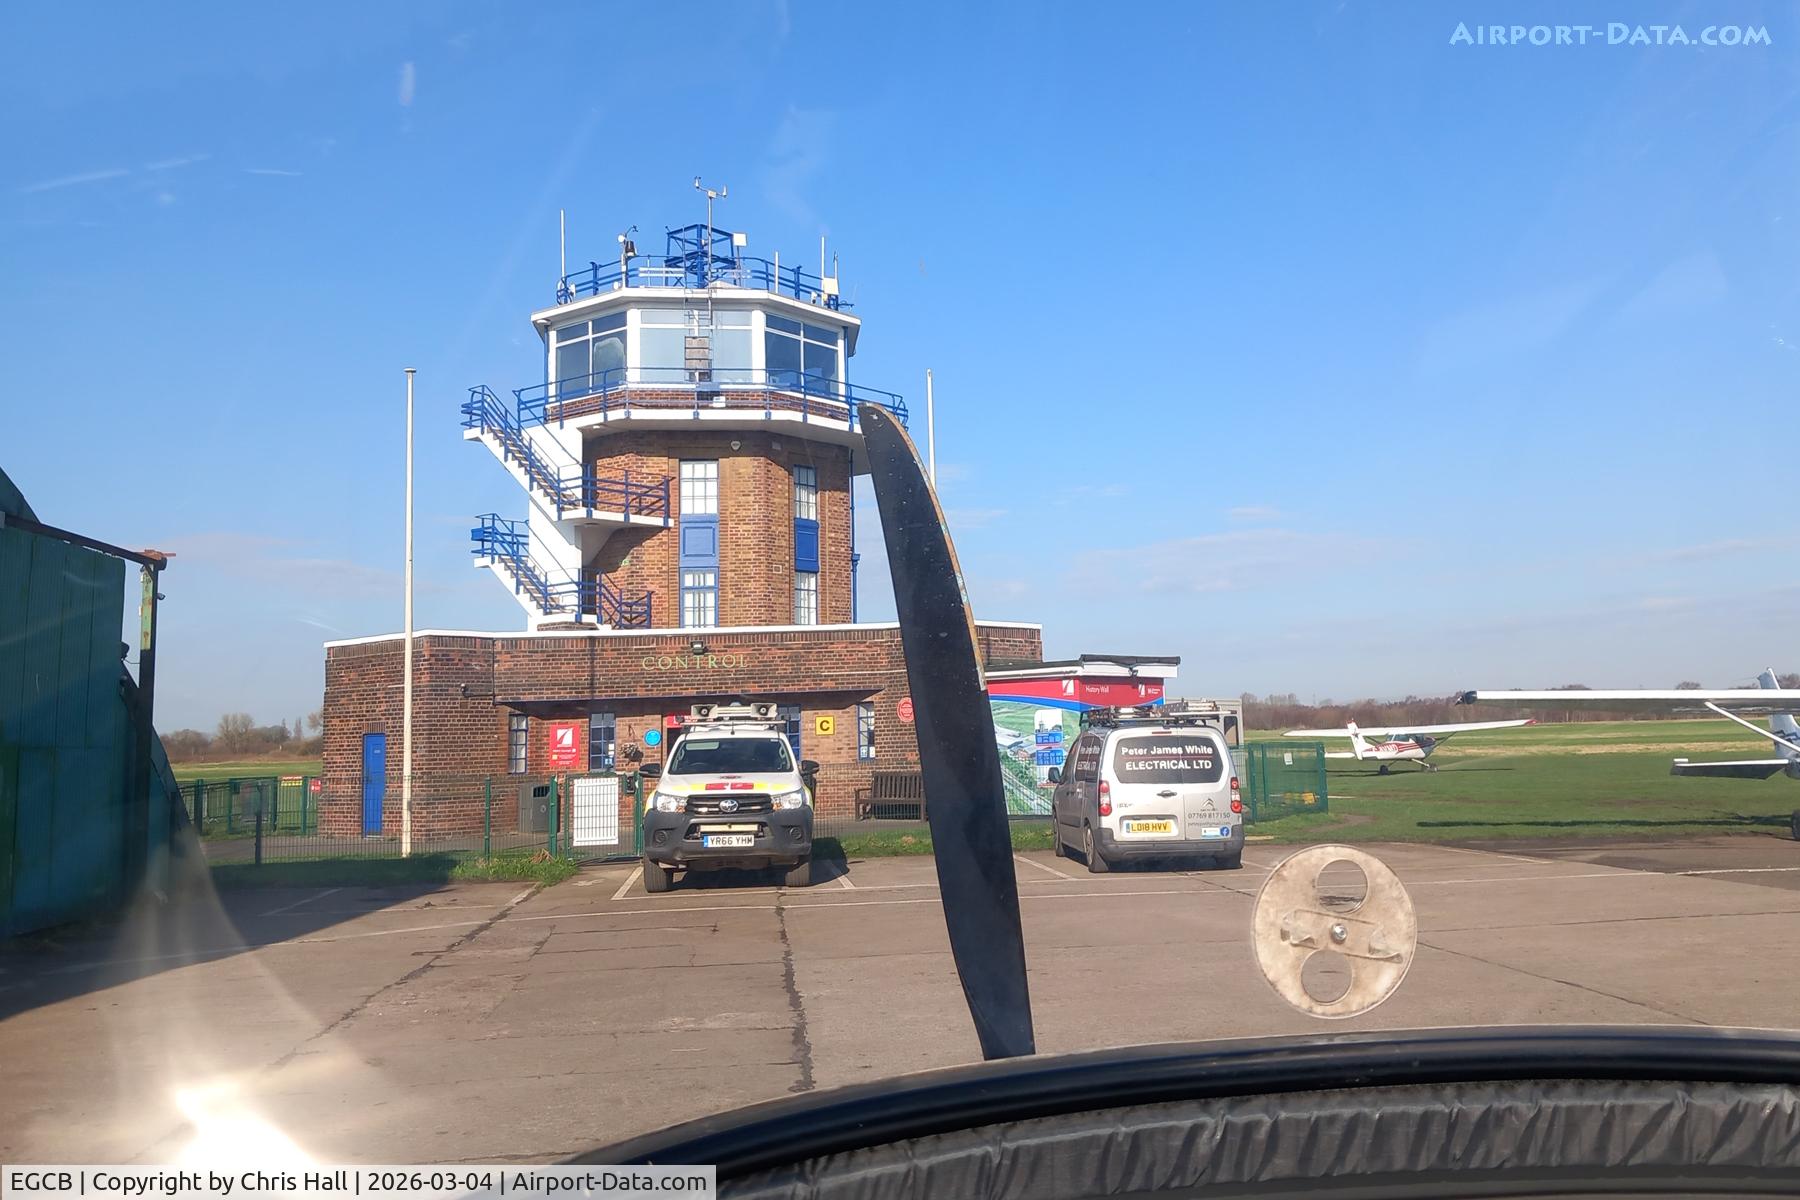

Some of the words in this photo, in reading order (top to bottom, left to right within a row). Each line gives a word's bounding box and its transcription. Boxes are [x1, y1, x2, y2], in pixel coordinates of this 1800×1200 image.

[642, 654, 748, 670] CONTROL
[1085, 685, 1100, 694] History
[1100, 685, 1110, 693] Wall
[820, 720, 830, 732] C
[1121, 746, 1147, 756] Peter
[1150, 746, 1183, 754] James
[1184, 745, 1213, 754] White
[1126, 760, 1191, 770] ELECTRICAL
[1193, 760, 1212, 769] LTD
[1131, 822, 1150, 832] LO18
[1152, 822, 1168, 831] HVV
[710, 836, 732, 846] YR66
[736, 836, 753, 845] YHM
